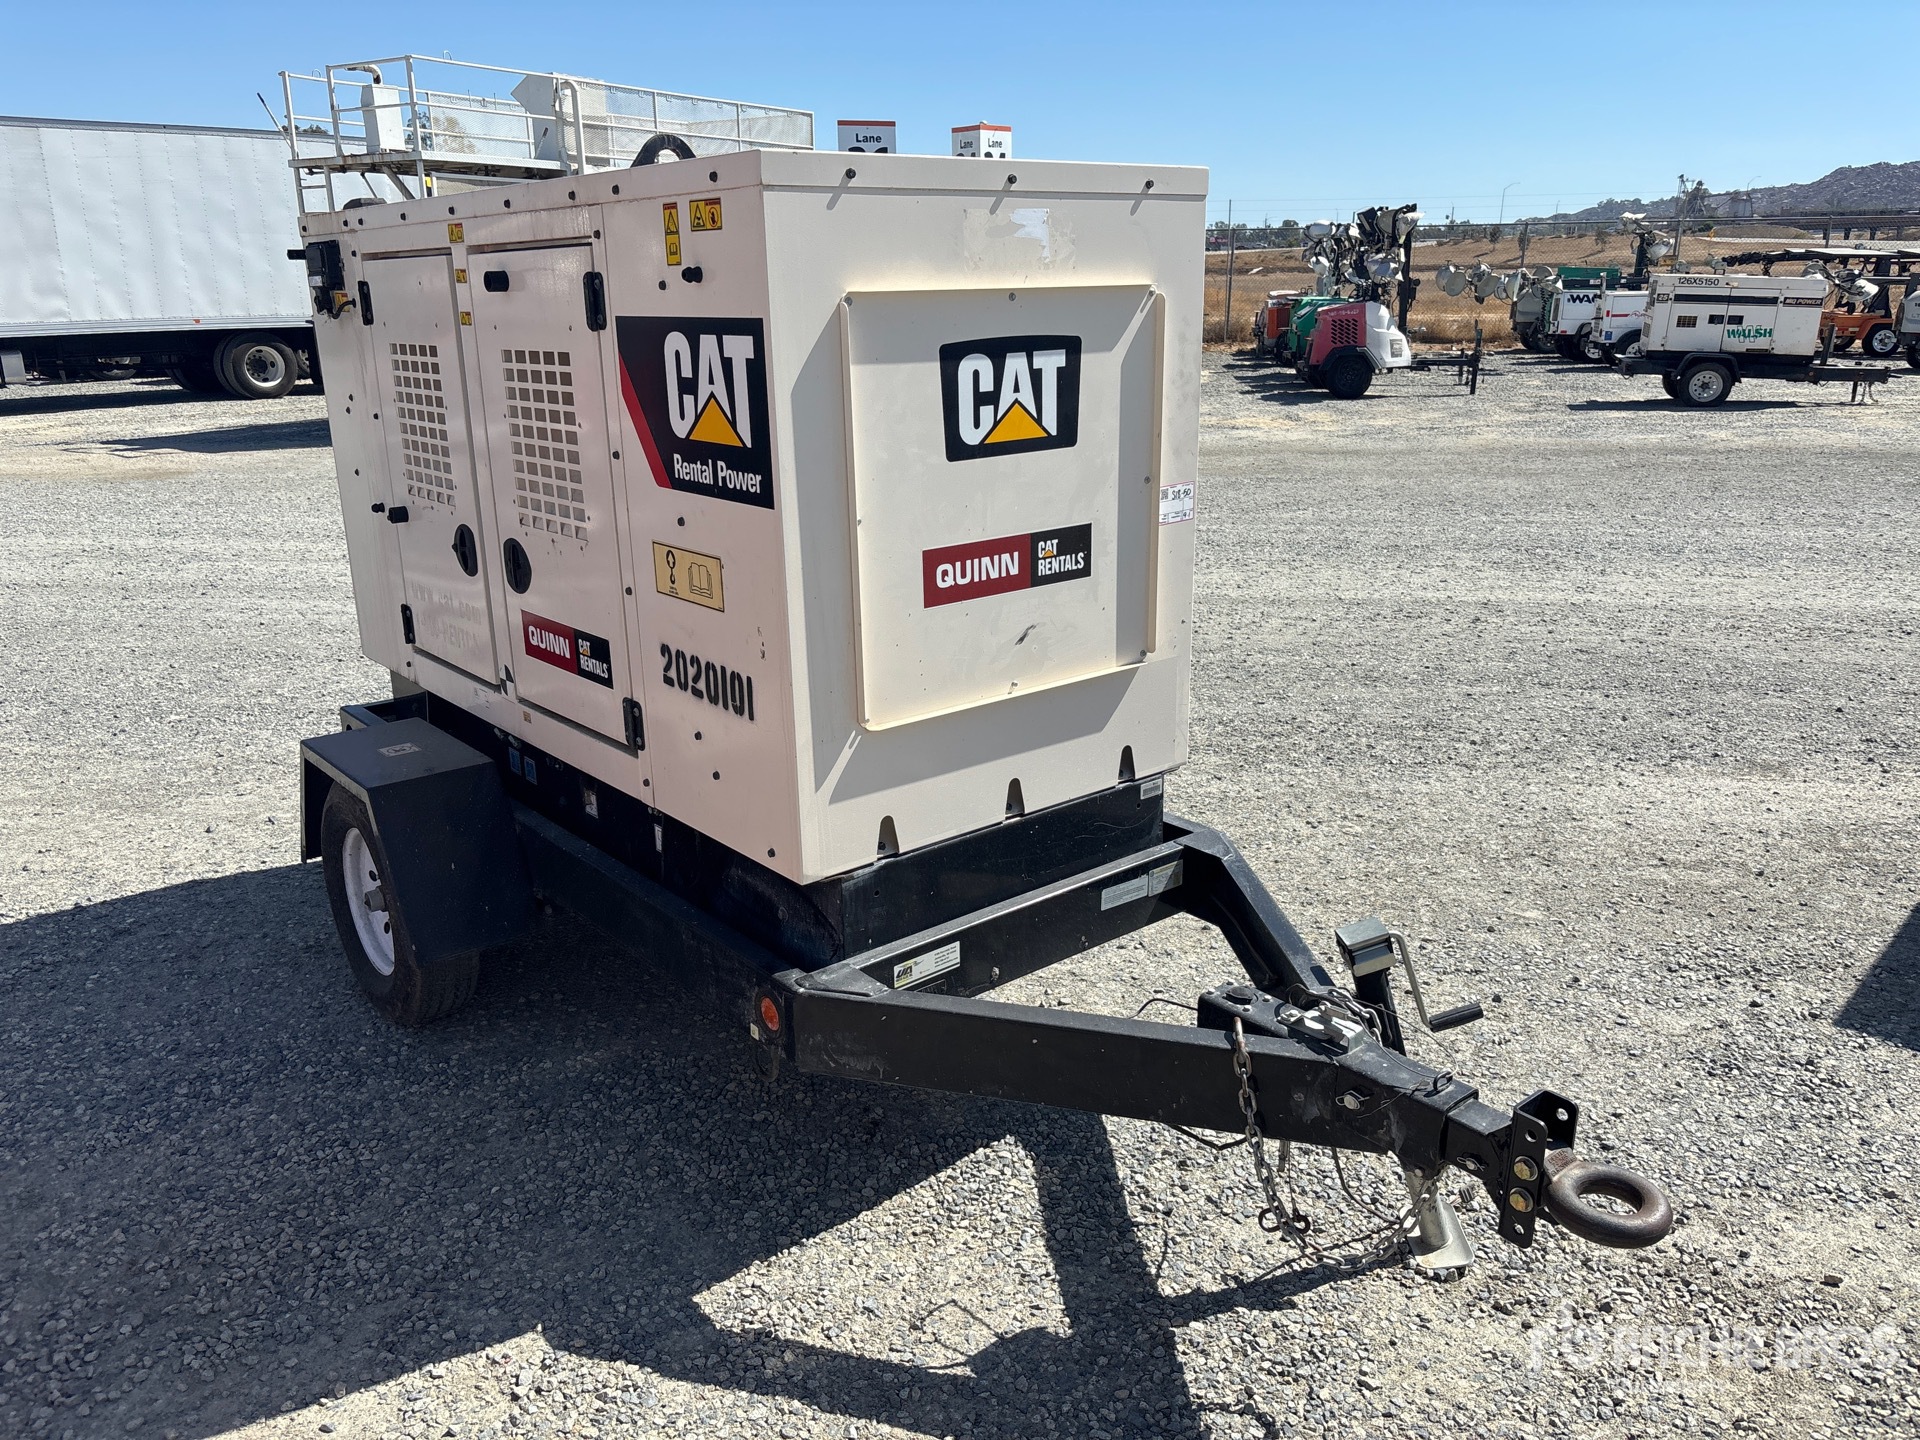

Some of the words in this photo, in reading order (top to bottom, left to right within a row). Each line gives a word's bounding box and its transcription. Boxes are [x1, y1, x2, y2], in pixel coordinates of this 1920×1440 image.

[855, 133, 882, 144] Lane
[959, 139, 974, 150] Lane
[987, 137, 1003, 149] Lane
[1677, 277, 1720, 286] 126X5150
[1726, 327, 1774, 340] WALSH
[664, 331, 755, 448] CAT
[957, 349, 1066, 446] CAT
[673, 453, 714, 486] Rental
[717, 460, 762, 494] Power
[1038, 538, 1059, 558] CAT
[935, 551, 1019, 588] QUINN
[1038, 552, 1086, 577] RENTALS
[528, 625, 571, 659] QUINN
[577, 637, 591, 656] CAT
[579, 654, 609, 680] RENTALS
[660, 642, 755, 722] 2020101
